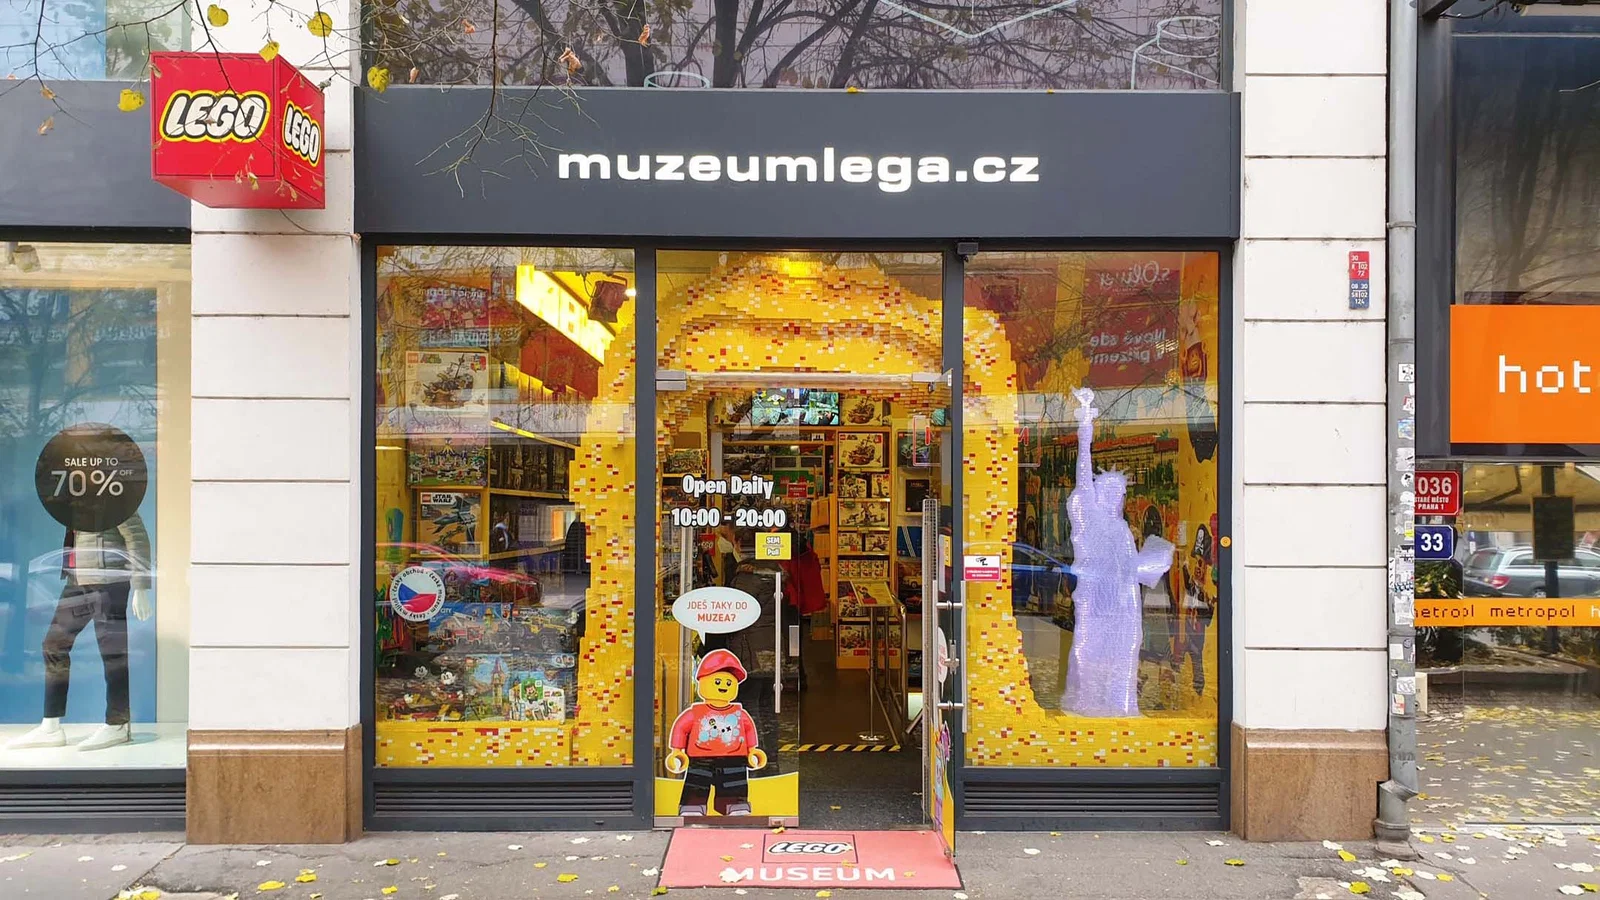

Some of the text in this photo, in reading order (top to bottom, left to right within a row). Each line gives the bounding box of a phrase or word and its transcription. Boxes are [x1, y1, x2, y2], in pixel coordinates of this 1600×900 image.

[163, 93, 268, 140] LEGO
[284, 103, 320, 163] LEGO
[558, 148, 1040, 193] muzeumlega.cz
[1499, 355, 1600, 393] hot
[64, 457, 119, 467] SALE UP TO
[51, 469, 124, 497] 70%
[682, 474, 774, 500] Open Daily
[1414, 476, 1452, 496] 036
[671, 507, 721, 527] 10:00
[735, 508, 786, 528] 20:00
[766, 536, 780, 544] SEM
[1420, 533, 1444, 552] 33
[687, 600, 748, 610] JDEŠ TAKY DO
[1490, 605, 1575, 620] metropol
[697, 613, 737, 622] MUZEA?
[767, 841, 852, 856] LEGO
[724, 867, 895, 882] MUSEUM
